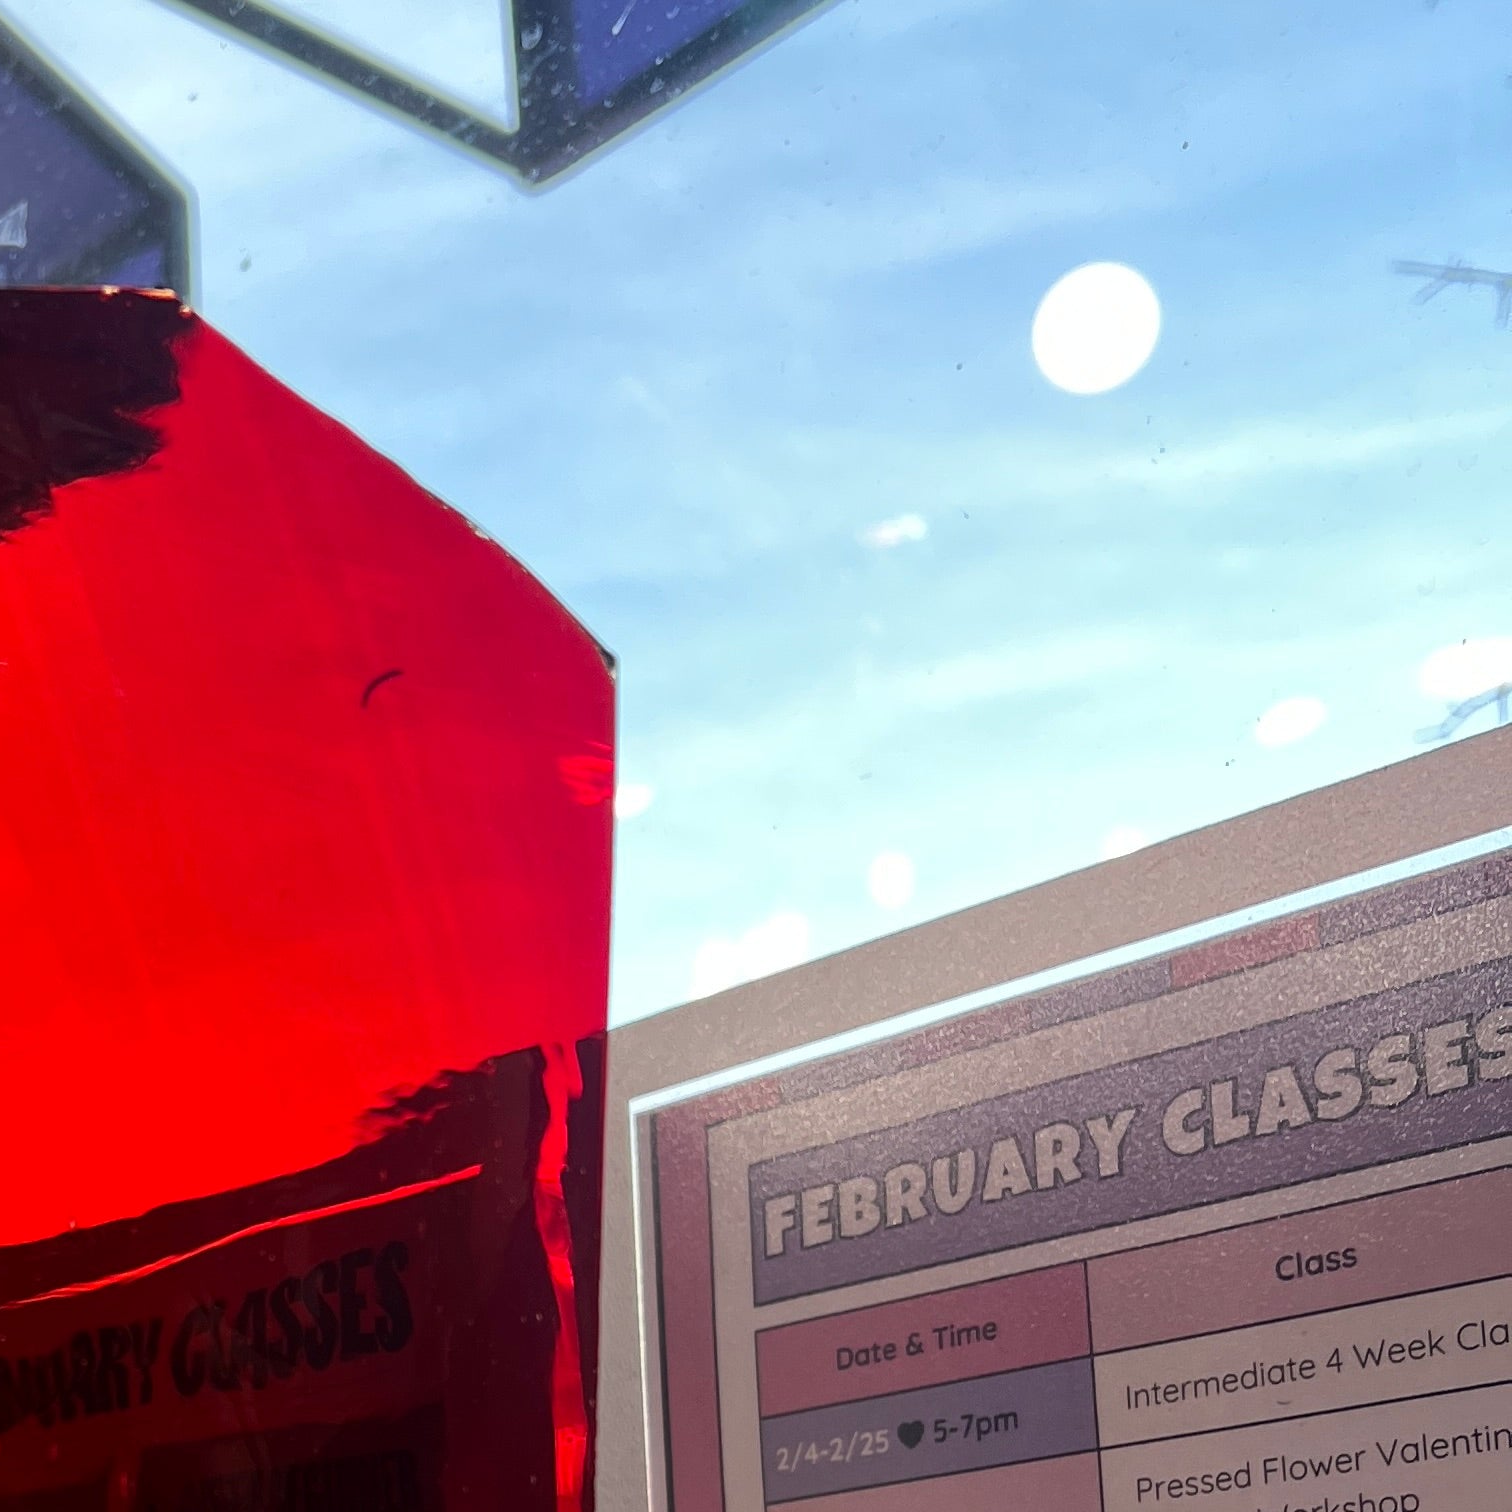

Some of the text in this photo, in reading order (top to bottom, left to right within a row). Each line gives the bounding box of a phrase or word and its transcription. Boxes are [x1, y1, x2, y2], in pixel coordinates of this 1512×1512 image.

[761, 1104, 1143, 1259] FEBRUARY
[1274, 1247, 1358, 1282] Class
[837, 1320, 998, 1371] Date & Time
[1126, 1320, 1511, 1410] Intermediate 4 Week Cla
[775, 1410, 1019, 1473] 2/4-2/25 5-7pm
[1136, 1426, 1512, 1502] Pressed Flower Valentin
